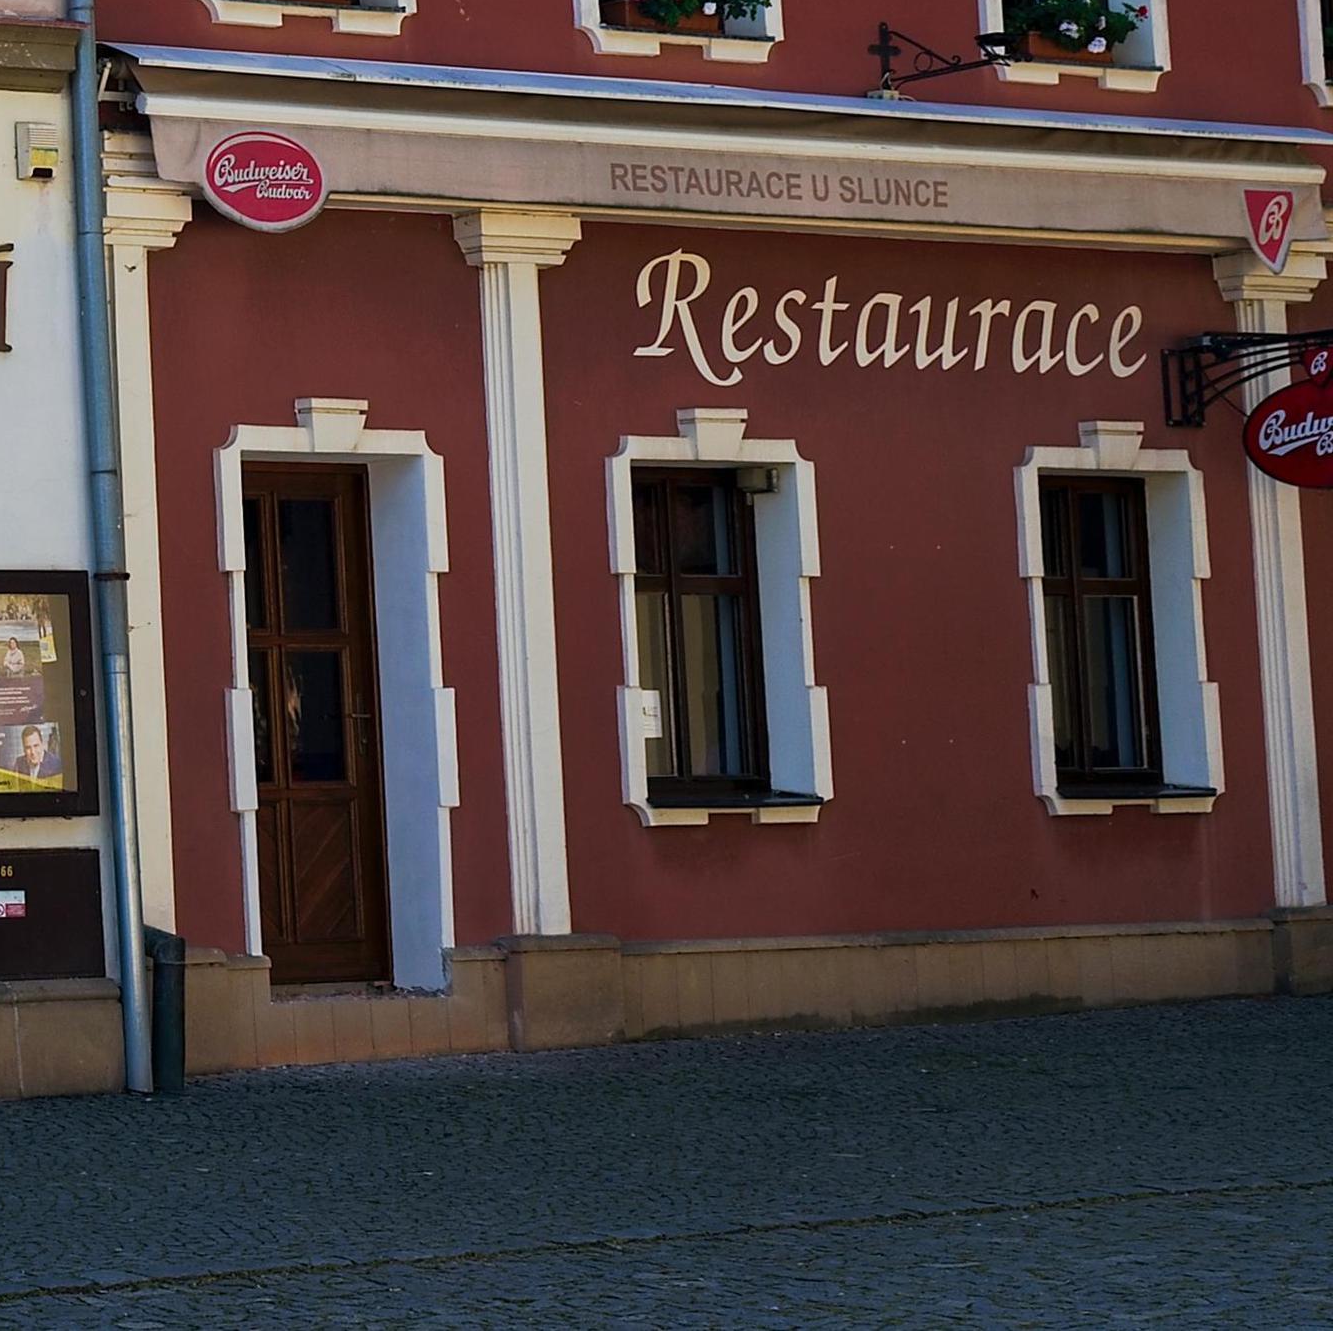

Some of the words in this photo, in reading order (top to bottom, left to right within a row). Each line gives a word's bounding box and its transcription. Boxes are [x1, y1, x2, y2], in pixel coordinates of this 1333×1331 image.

[213, 153, 314, 187] Budweiser
[609, 161, 803, 201] RESTAURACE
[811, 174, 831, 202] U
[838, 176, 949, 209] SLUNCE
[255, 179, 313, 201] Budvar
[633, 247, 1148, 387] Restaurace
[0, 865, 13, 877] 66
